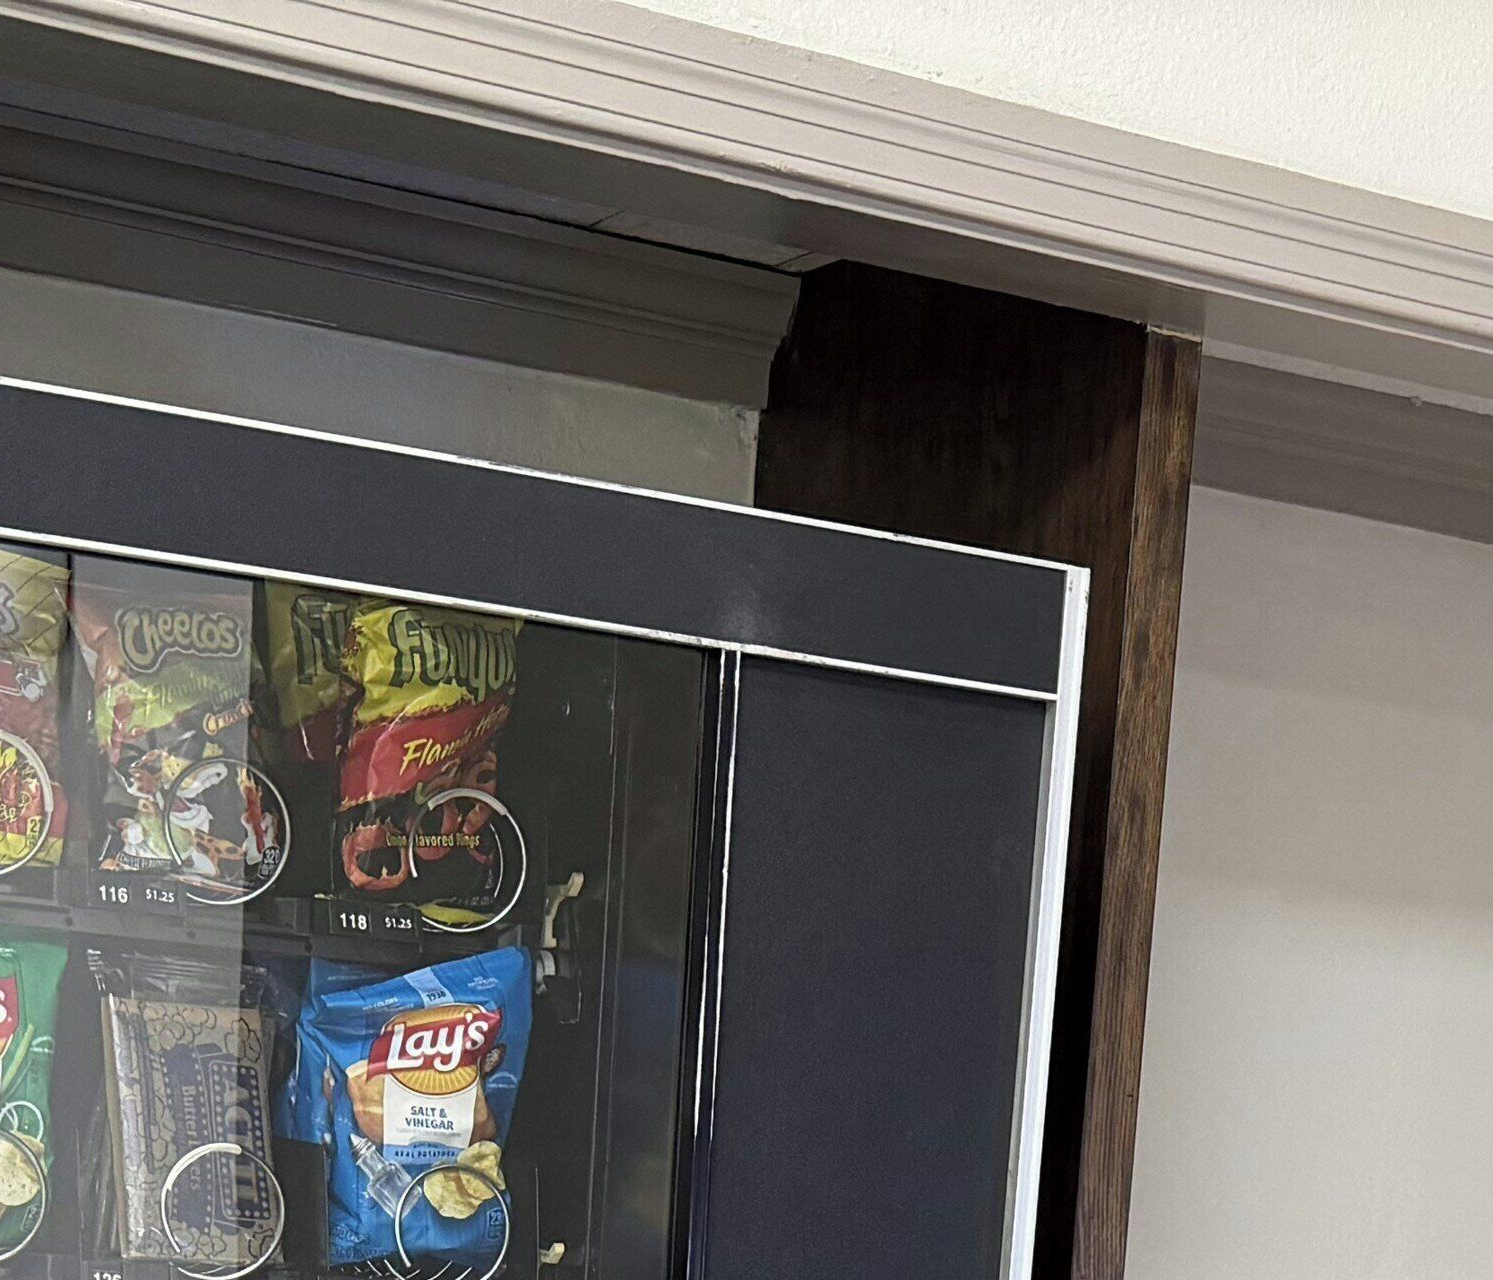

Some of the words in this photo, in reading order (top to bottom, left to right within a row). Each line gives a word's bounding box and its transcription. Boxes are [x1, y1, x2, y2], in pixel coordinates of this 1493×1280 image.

[117, 610, 242, 668] Cheetos
[98, 885, 128, 904] 116
[145, 889, 175, 903] $1.25
[339, 913, 368, 929] 118
[384, 916, 413, 930] $1.25
[386, 1012, 489, 1073] Lay's
[181, 1085, 201, 1136] Butter
[410, 1105, 436, 1117] SALT
[437, 1107, 448, 1119] &
[404, 1116, 454, 1132] VINEGAR
